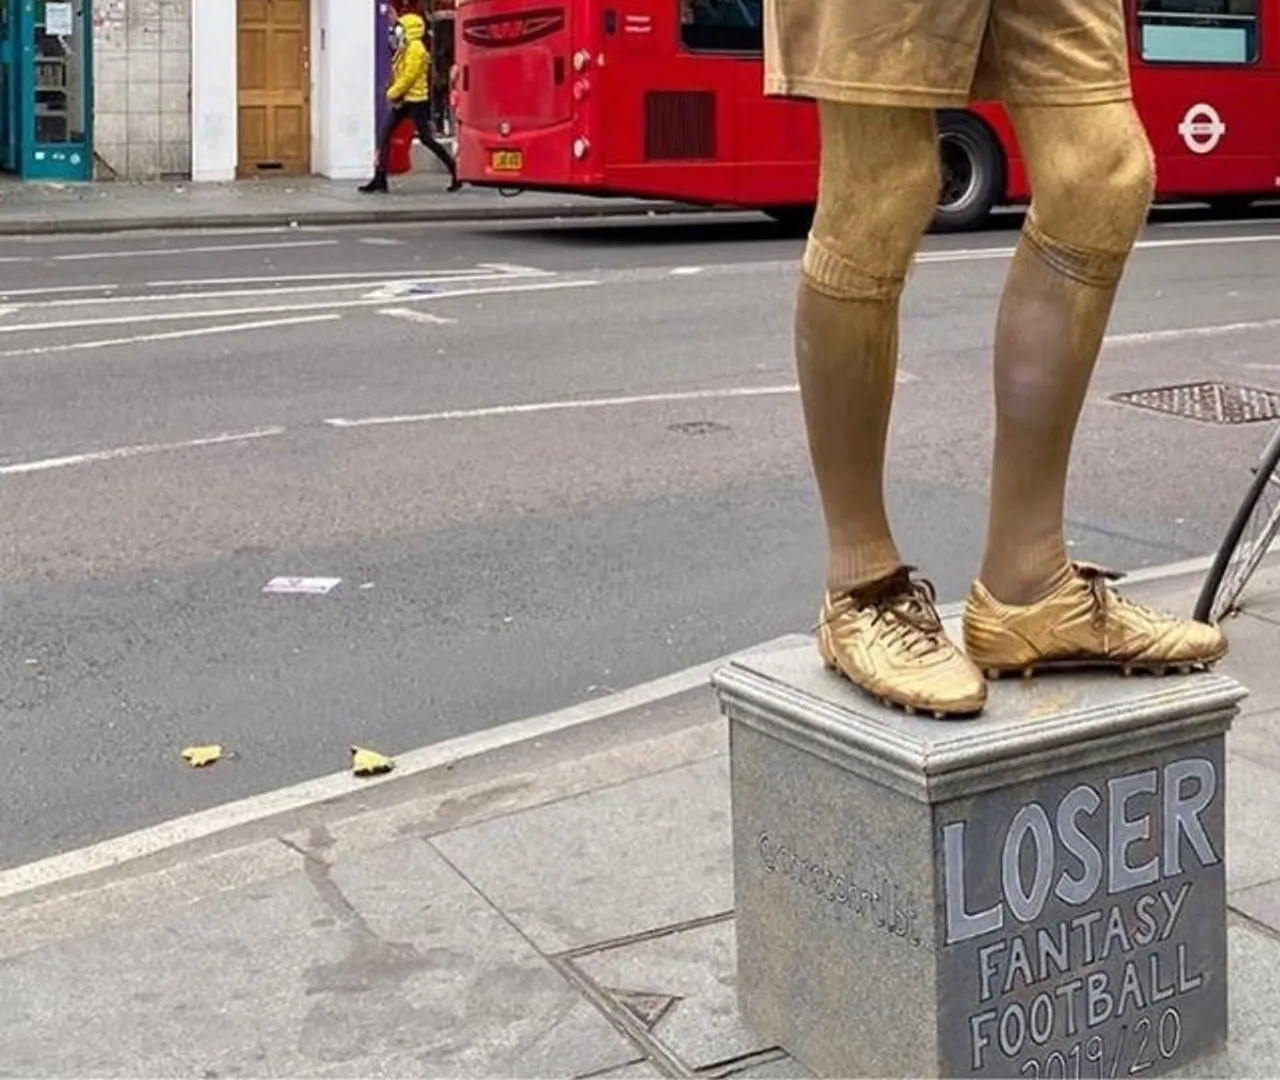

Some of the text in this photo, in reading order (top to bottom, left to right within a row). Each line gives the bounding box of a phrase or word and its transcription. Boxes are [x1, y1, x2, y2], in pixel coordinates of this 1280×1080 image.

[940, 758, 1222, 946] LOSER
[977, 882, 1193, 1002] FANTASY
[969, 943, 1203, 1070] FOOTBALL
